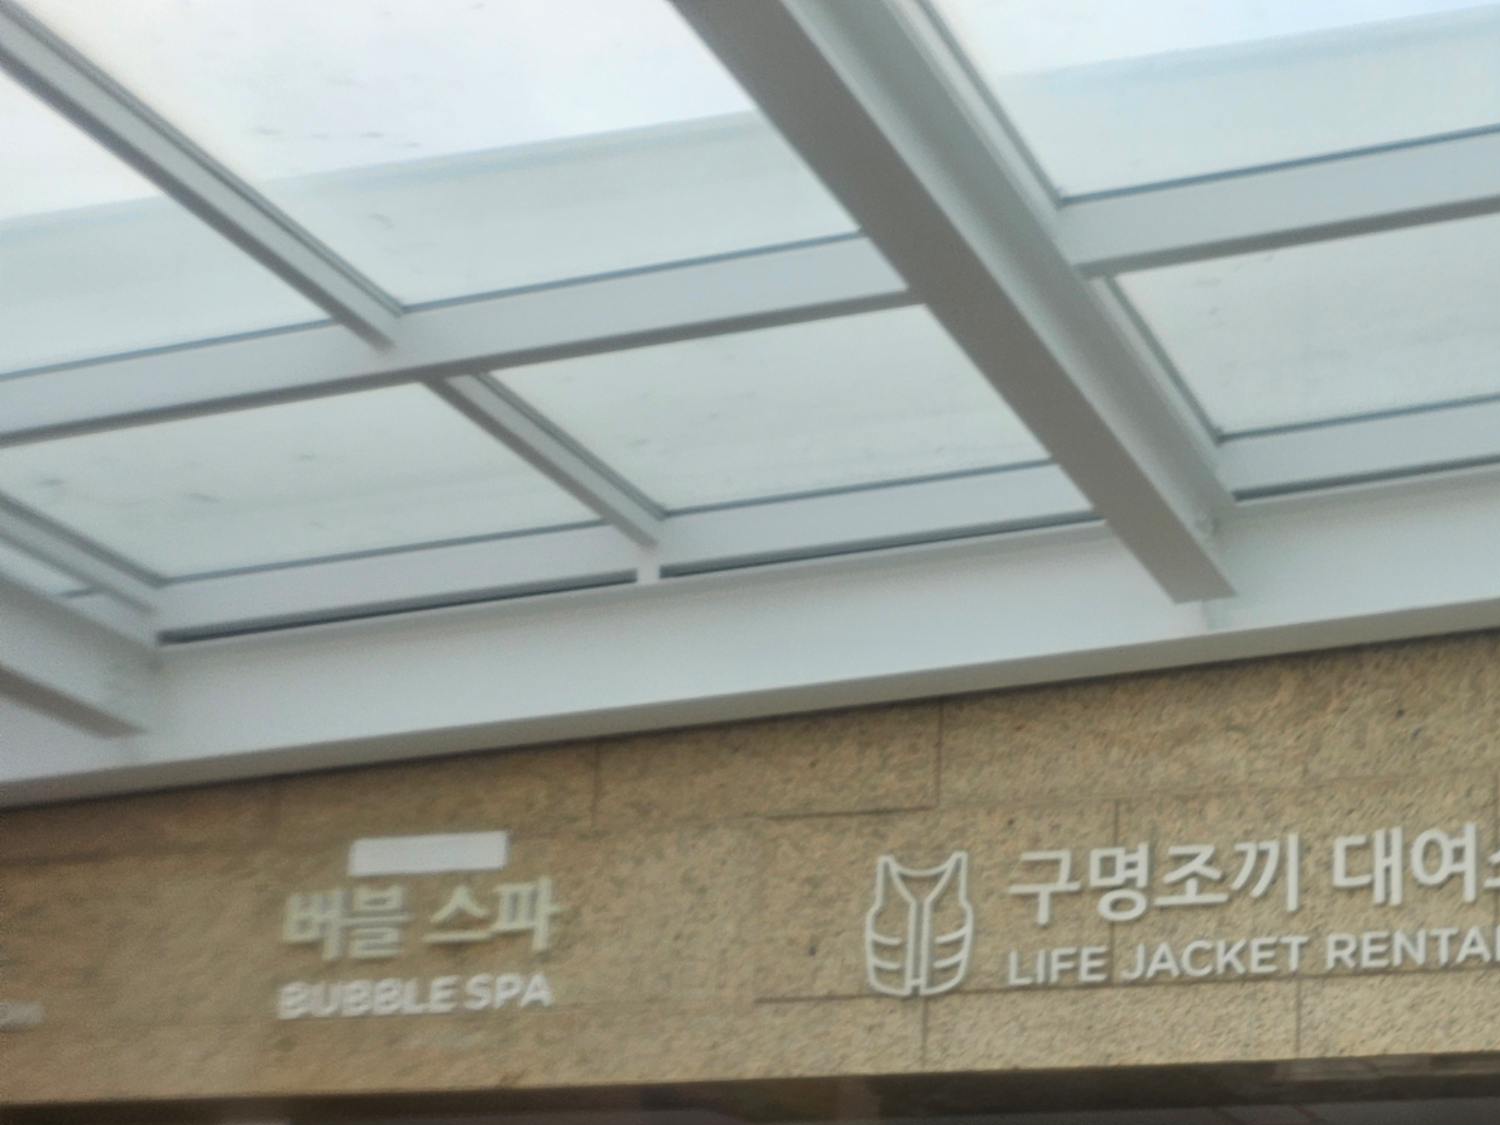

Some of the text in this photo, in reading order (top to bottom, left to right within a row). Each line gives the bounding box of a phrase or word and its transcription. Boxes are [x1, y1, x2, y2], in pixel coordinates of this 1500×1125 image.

[1008, 832, 1299, 926] 구명조끼
[281, 876, 560, 962] 버블 스파
[1007, 945, 1110, 987] LIFE
[1120, 934, 1310, 981] JACKET
[276, 971, 554, 1021] BUBBLE SPA
